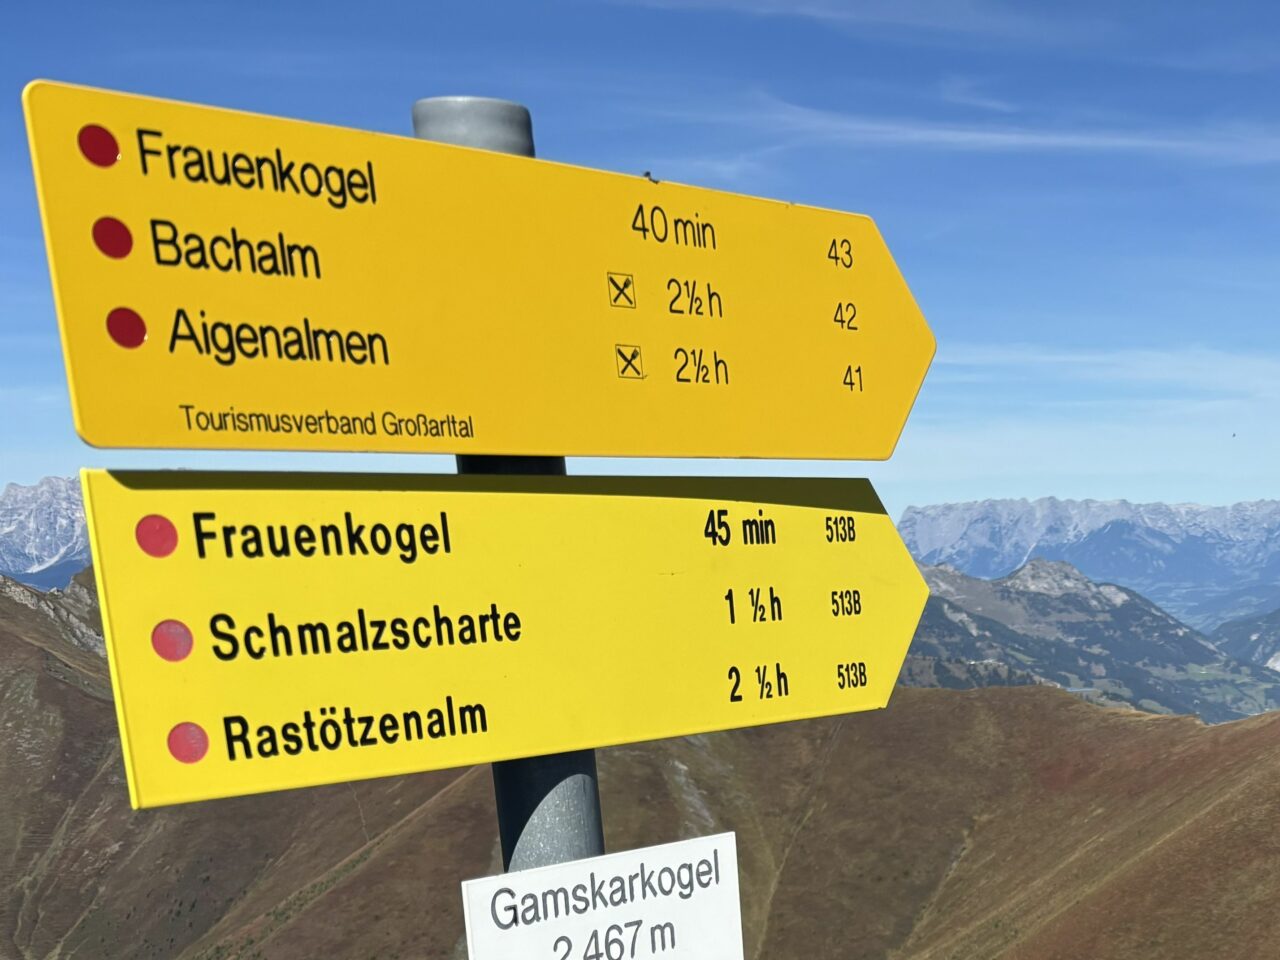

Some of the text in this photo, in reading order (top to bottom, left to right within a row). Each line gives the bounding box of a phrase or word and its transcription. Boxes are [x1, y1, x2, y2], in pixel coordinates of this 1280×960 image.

[136, 128, 377, 210] Frauenkogel
[827, 238, 853, 269] 43
[149, 218, 321, 279] Bachalm
[833, 302, 858, 331] 42
[168, 308, 390, 367] Aigenalmen
[842, 365, 863, 392] 41
[178, 404, 474, 438] Tourismusverband Großarltal
[192, 509, 856, 565] Frauenkogel 45 min 513B
[209, 603, 522, 662] Schmalzscharte
[831, 589, 862, 617] 513B
[222, 695, 488, 762] Rastötzenalm
[837, 662, 868, 690] 513B
[489, 848, 721, 931] Gamskarkogel
[650, 921, 676, 954] m
